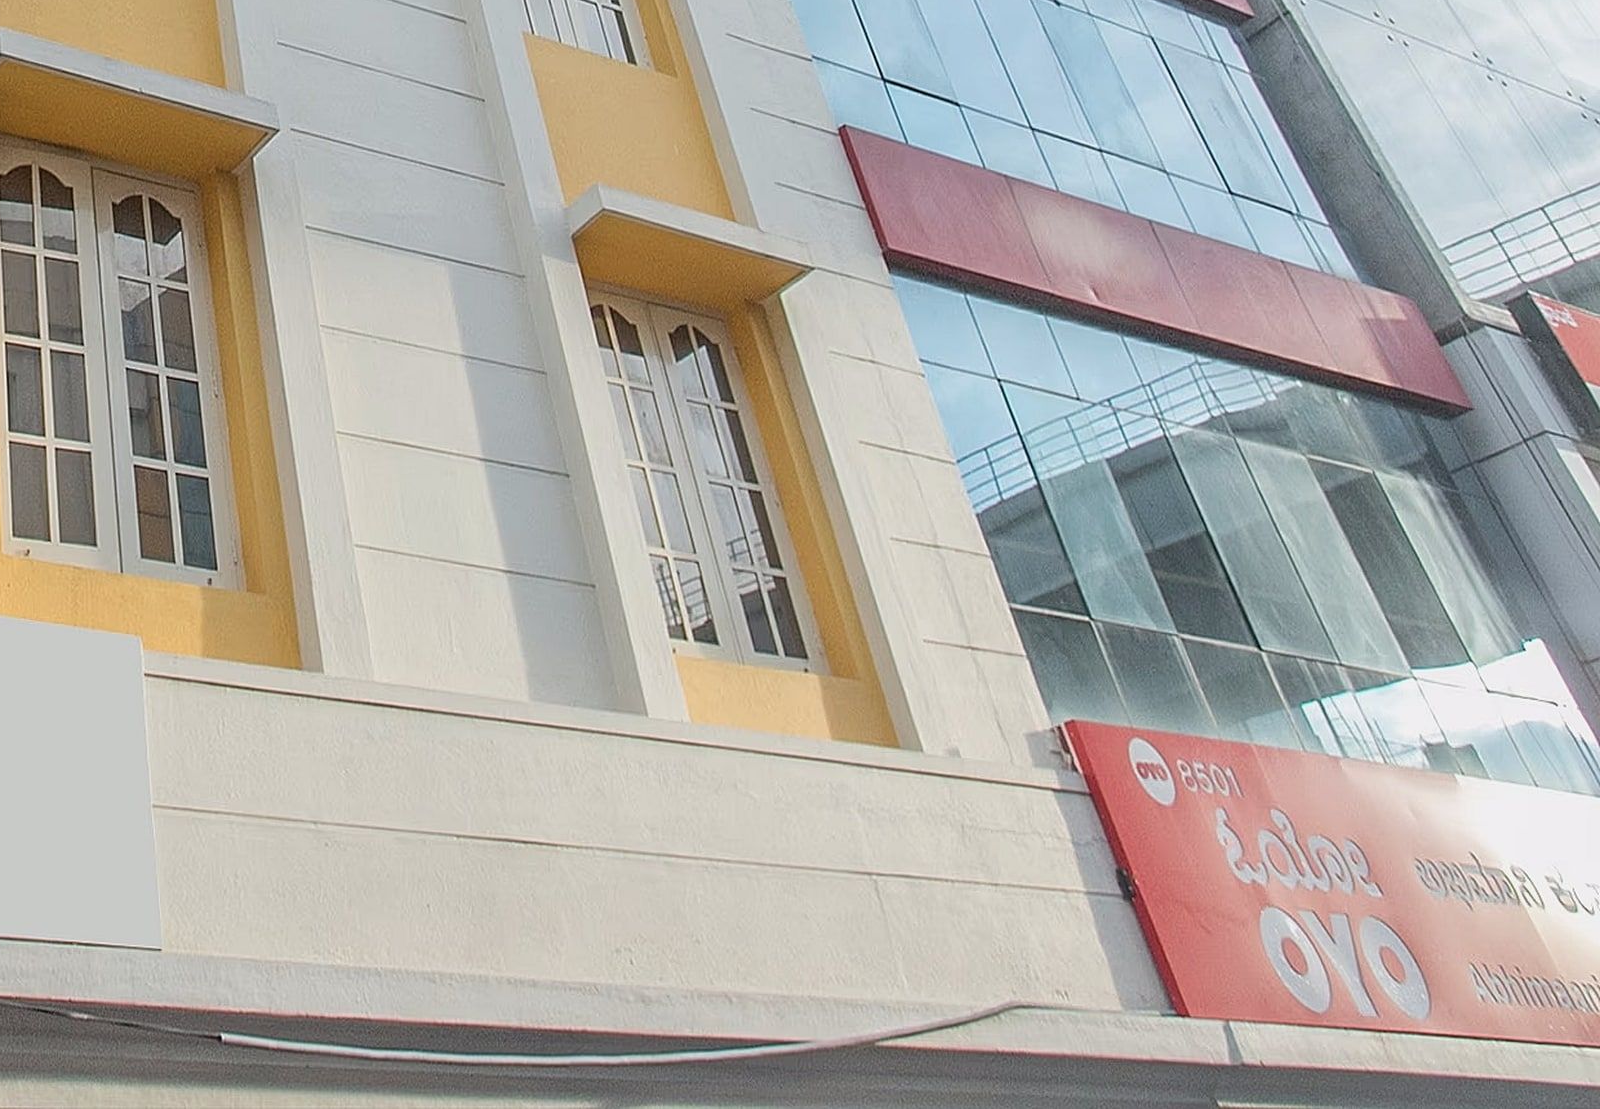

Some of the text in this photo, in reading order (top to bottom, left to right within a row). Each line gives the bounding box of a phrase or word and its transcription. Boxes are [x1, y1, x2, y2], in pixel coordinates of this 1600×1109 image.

[1135, 762, 1169, 781] OYO
[1176, 756, 1245, 799] 8501
[1259, 906, 1432, 1021] OYO
